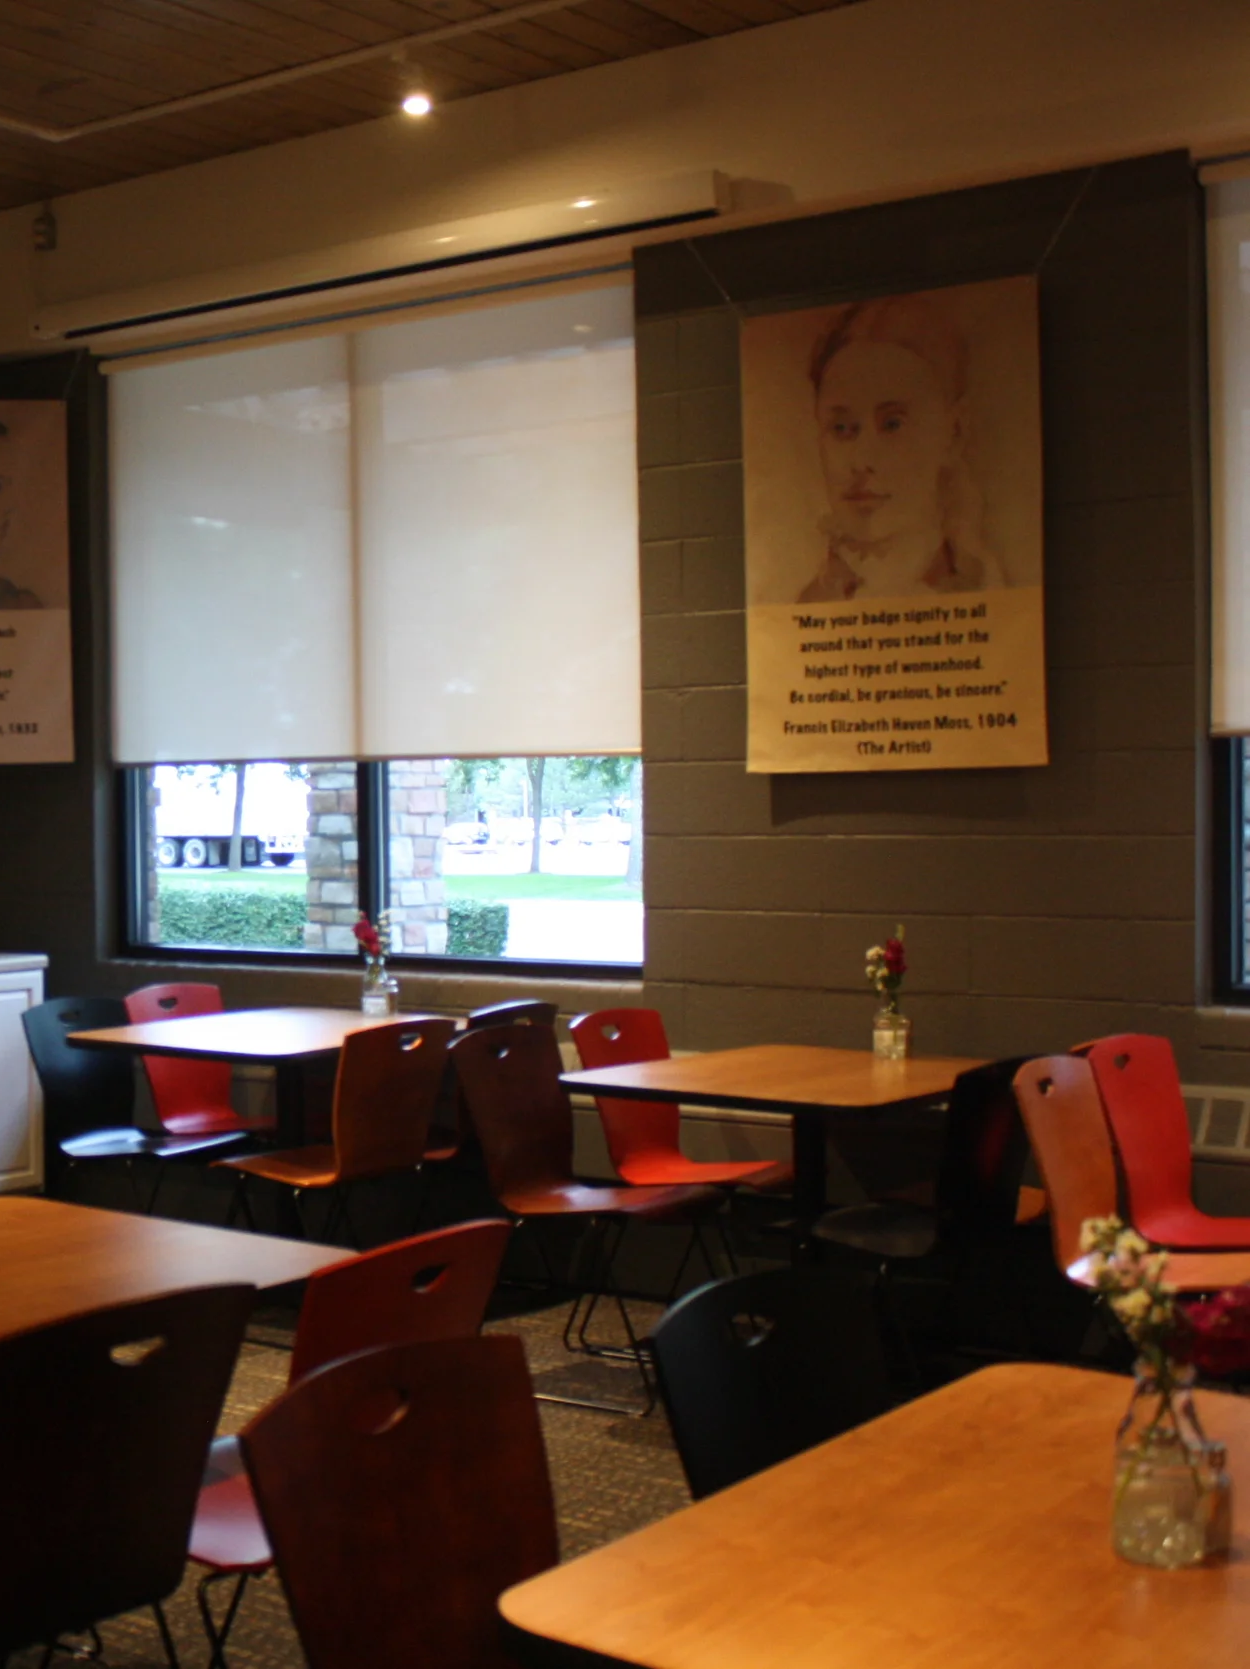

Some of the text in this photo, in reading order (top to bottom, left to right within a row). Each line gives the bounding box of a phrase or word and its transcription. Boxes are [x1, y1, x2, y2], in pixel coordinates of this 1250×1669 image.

[792, 603, 987, 630] "May your badge signify to all
[800, 629, 989, 652] around that you stand for the
[805, 655, 985, 680] highest type of womanhood.
[790, 690, 804, 704] Be
[807, 687, 855, 704] cordial,
[857, 687, 871, 702] be
[874, 686, 933, 703] gracious,
[936, 684, 951, 699] be
[831, 718, 889, 734] Elizabeth
[892, 717, 931, 732] Haven
[934, 715, 973, 731] Moss,
[857, 739, 932, 755] (The Artist)
